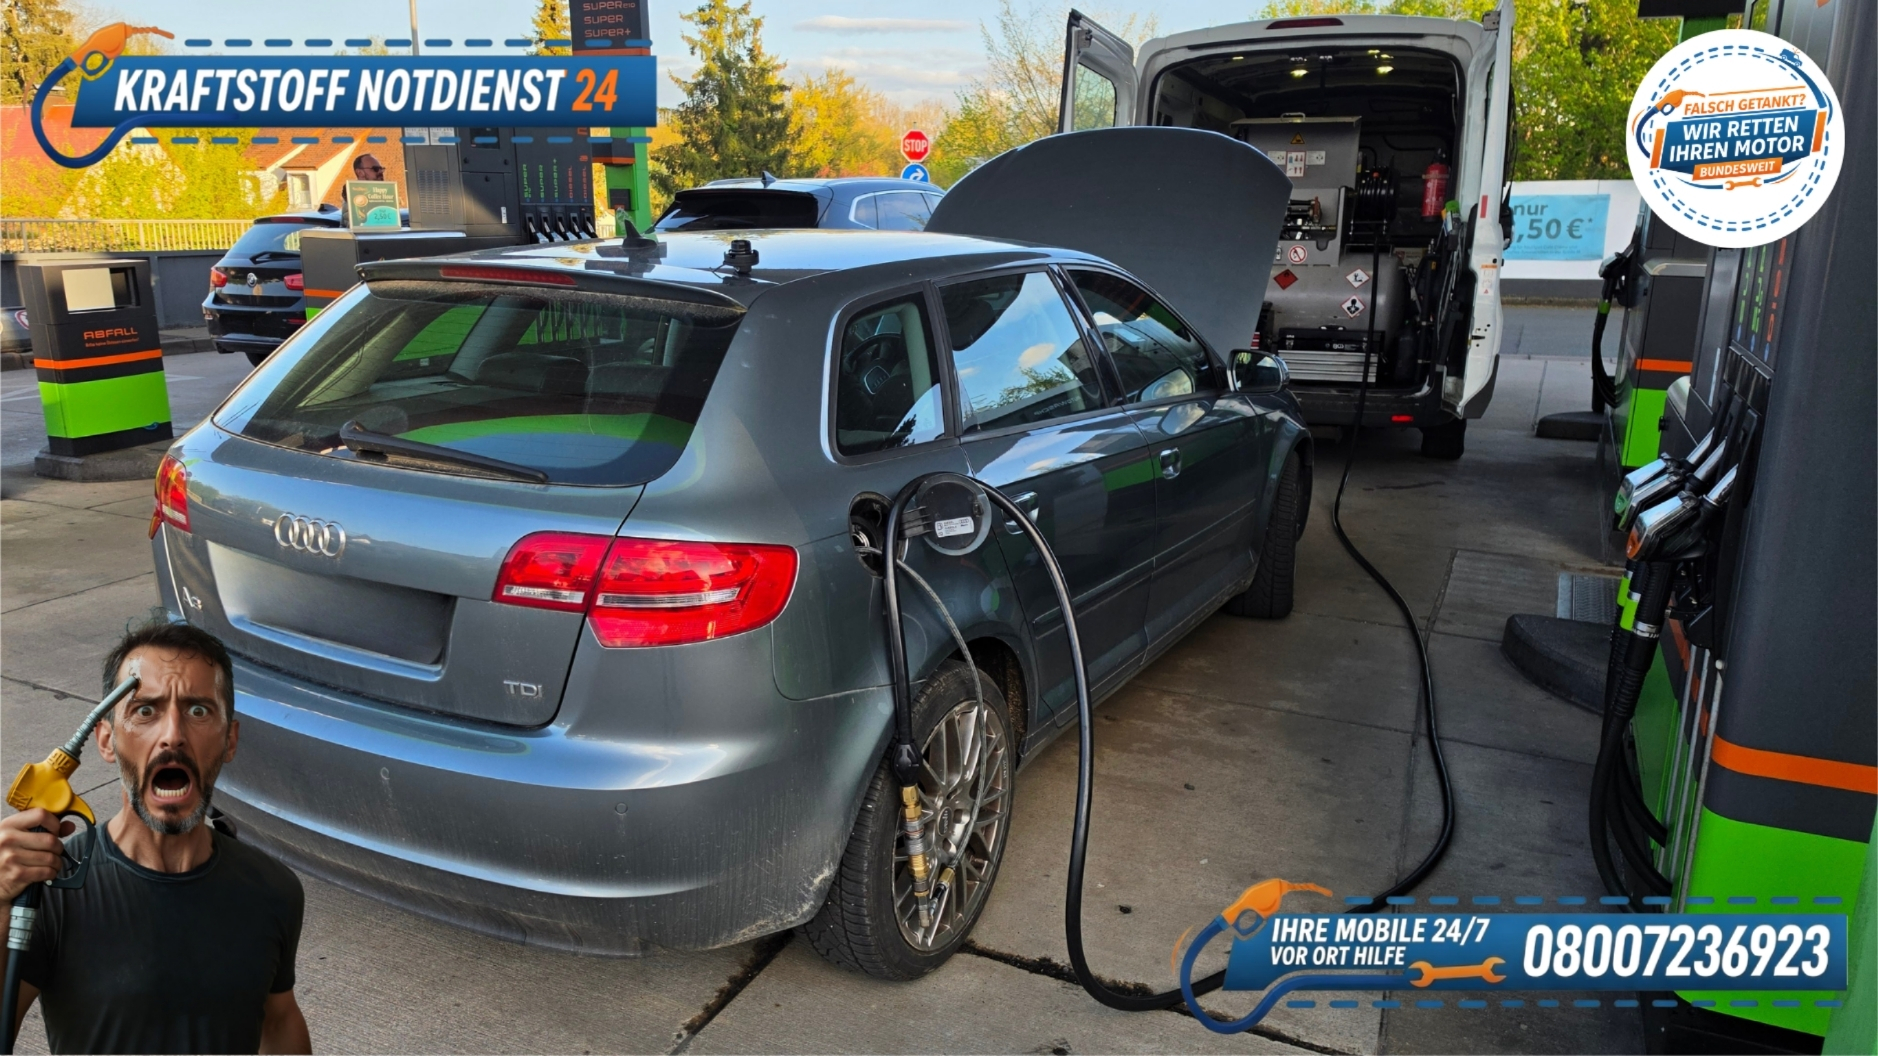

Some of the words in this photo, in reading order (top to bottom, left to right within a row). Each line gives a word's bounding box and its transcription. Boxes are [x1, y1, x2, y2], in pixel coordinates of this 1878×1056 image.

[584, 15, 623, 24] SUPER
[585, 28, 631, 37] SUPER+
[904, 139, 927, 153] STOP
[1513, 203, 1548, 216] nur
[1516, 218, 1562, 243] ,50
[83, 327, 138, 340] ABFALL
[503, 681, 543, 698] TDI
